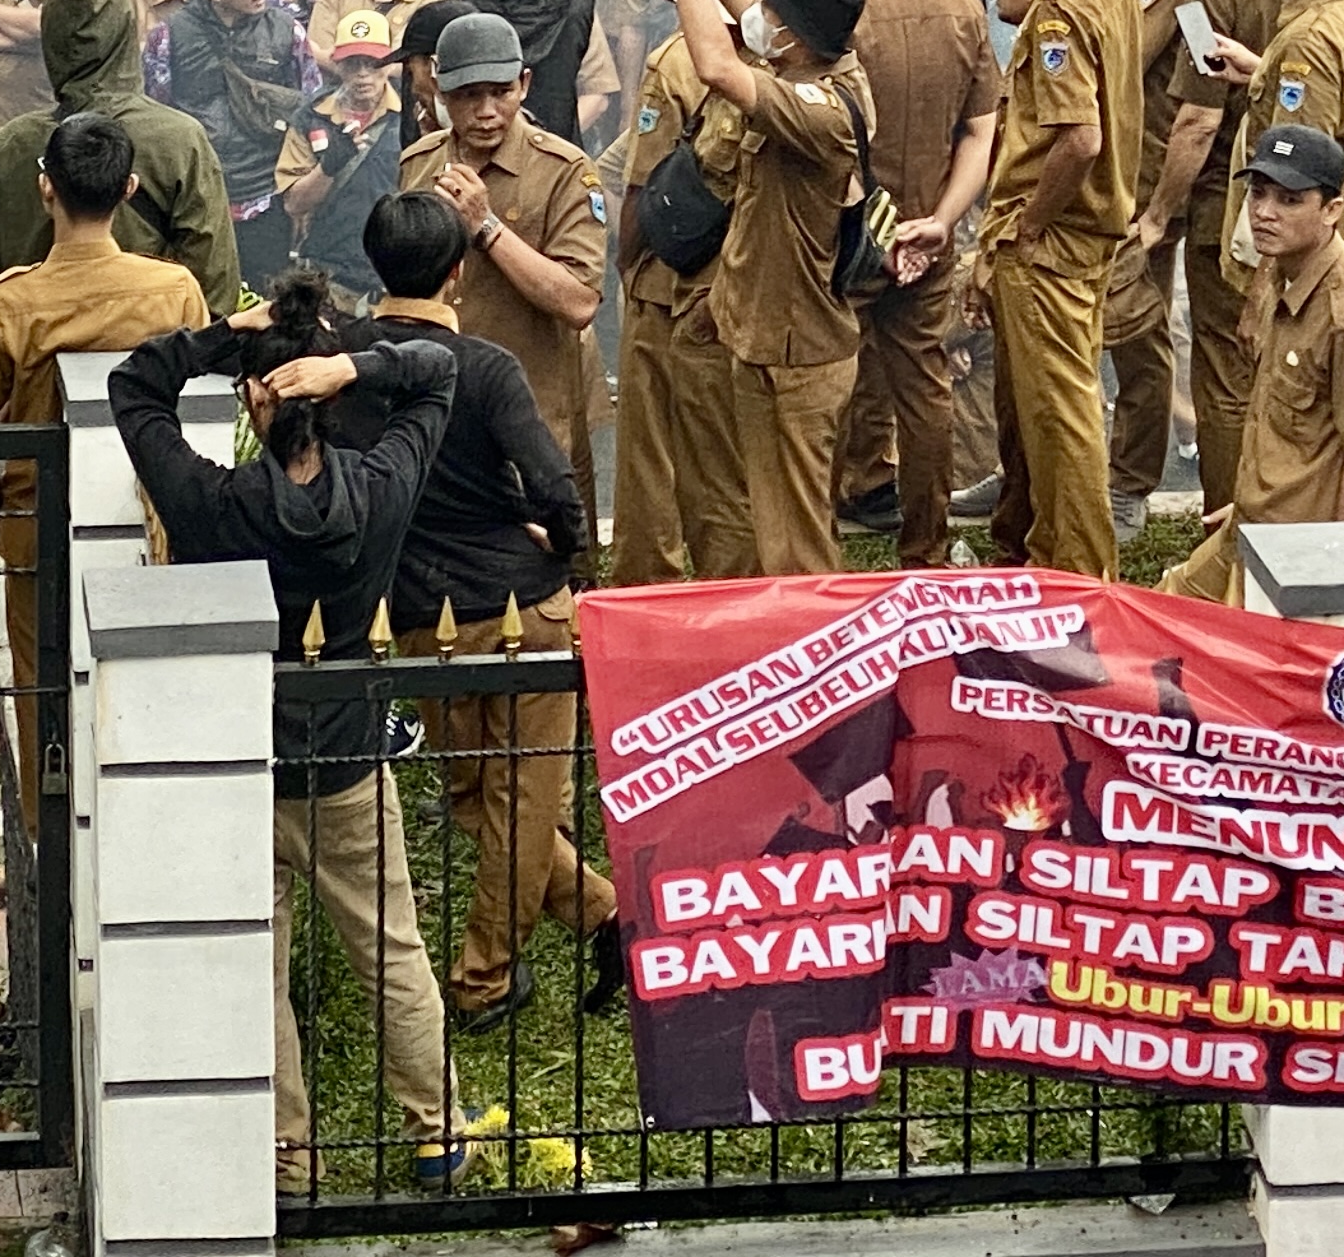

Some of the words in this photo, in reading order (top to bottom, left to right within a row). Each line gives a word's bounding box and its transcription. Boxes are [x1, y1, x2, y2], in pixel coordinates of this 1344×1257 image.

[958, 683, 1183, 745] PERSATUAN
[610, 741, 719, 816] MOAL
[661, 832, 994, 924] BAYARAN
[1029, 849, 1270, 908] SILTAP
[976, 899, 1206, 965] SILTAP
[980, 1009, 1258, 1083] MUNDUR
